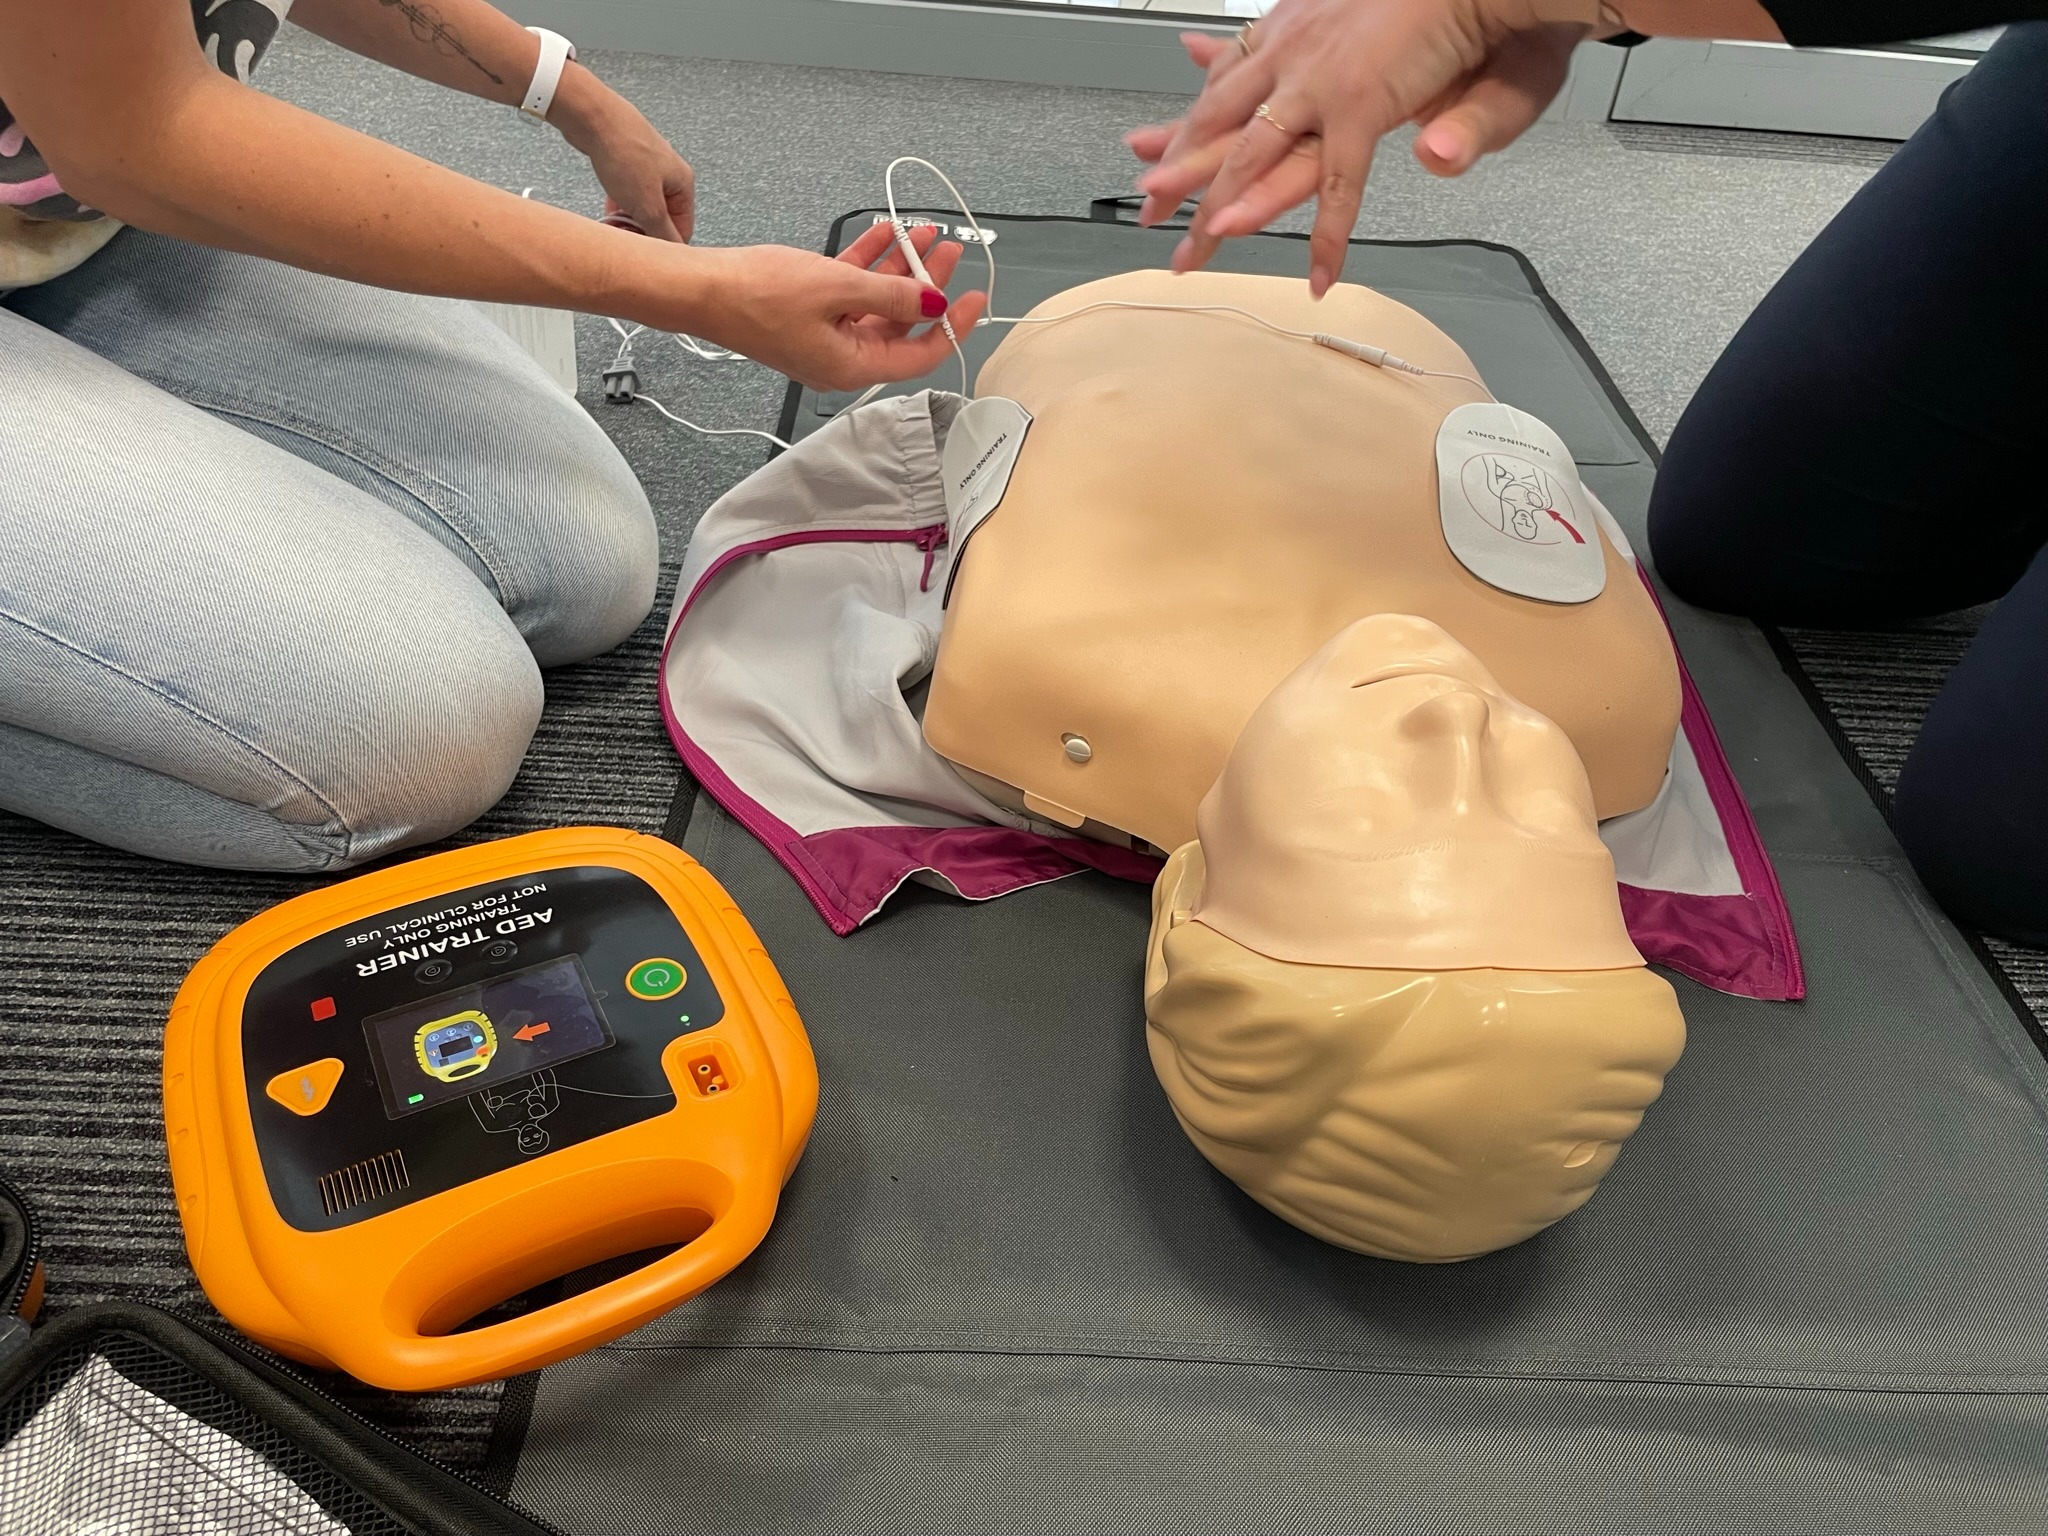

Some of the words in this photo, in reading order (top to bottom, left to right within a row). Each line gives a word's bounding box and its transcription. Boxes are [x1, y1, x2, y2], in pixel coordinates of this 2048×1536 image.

[1467, 430, 1496, 440] ONLY
[976, 433, 1007, 471] TRAINING
[1498, 437, 1551, 457] TRAINING
[960, 470, 977, 490] ONLY
[472, 895, 508, 910] FOR
[512, 883, 547, 901] NOT
[386, 906, 468, 934] CLINICAL
[435, 903, 521, 933] TRAINING
[496, 908, 553, 935] AED
[345, 930, 381, 948] USE
[383, 928, 431, 950] ONLY
[356, 928, 490, 977] TRAINER
